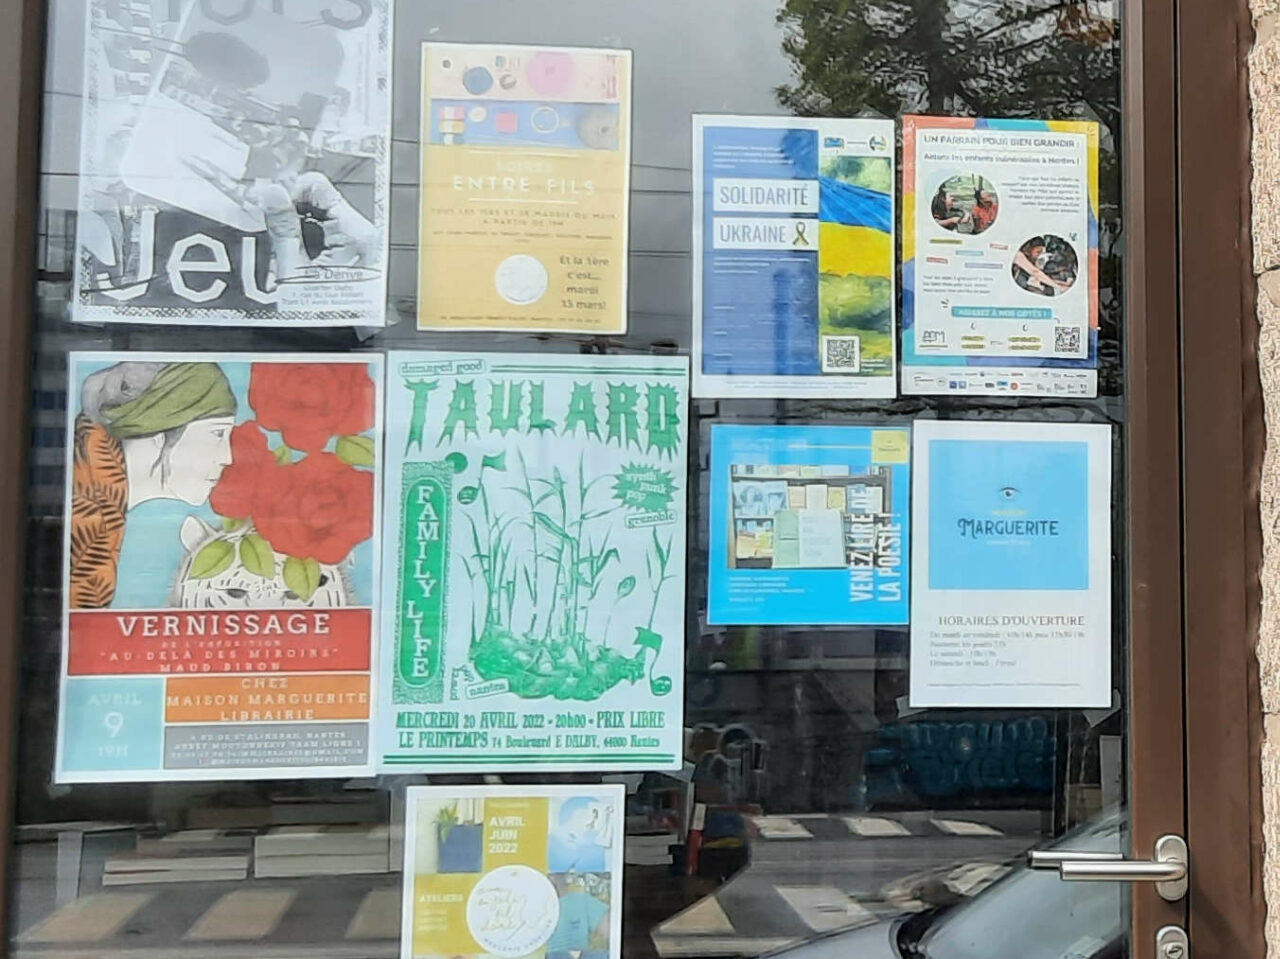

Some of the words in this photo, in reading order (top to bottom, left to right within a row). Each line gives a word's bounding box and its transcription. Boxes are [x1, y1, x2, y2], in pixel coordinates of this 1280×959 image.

[924, 135, 938, 143] UN
[1010, 138, 1032, 146] BIEN
[1033, 138, 1075, 148] GRANDIR
[453, 176, 530, 192] ENTRE
[547, 178, 595, 196] FILS
[720, 183, 808, 206] SOLIDARITÉ
[719, 220, 786, 243] UKRAINE
[559, 255, 570, 265] Et
[573, 255, 582, 265] la
[567, 285, 598, 295] mardi
[404, 378, 682, 462] TAULARD
[852, 488, 873, 509] DE
[850, 514, 874, 548] LIRE
[958, 518, 1060, 540] MARGUERITE
[414, 485, 440, 599] FAMILY
[850, 551, 874, 602] VENEZ
[878, 581, 901, 602] LA
[117, 613, 331, 637] VERNISSAGE
[938, 616, 999, 626] HORAIRES
[1002, 615, 1086, 626] D'OUVERTURE
[406, 600, 432, 679] LIFE
[242, 678, 289, 689] CHEZ
[88, 692, 143, 705] AVRIL
[167, 694, 239, 707] MAISON
[248, 692, 368, 705] MARGUERITE
[104, 712, 124, 738] 9
[220, 709, 315, 722] LIBRAIRIE
[396, 711, 460, 729] MERCREDI
[463, 714, 476, 729] 20
[480, 711, 519, 729] AVRIL
[522, 713, 545, 729] 2022
[555, 711, 586, 729] 20h00
[596, 711, 625, 728] PRIX
[630, 711, 665, 728] LIBRE
[399, 731, 415, 748] LE
[419, 731, 489, 749] PRINTEMPS
[489, 816, 526, 827] AVRIL
[488, 829, 519, 840] JUIN
[488, 842, 519, 854] 2022
